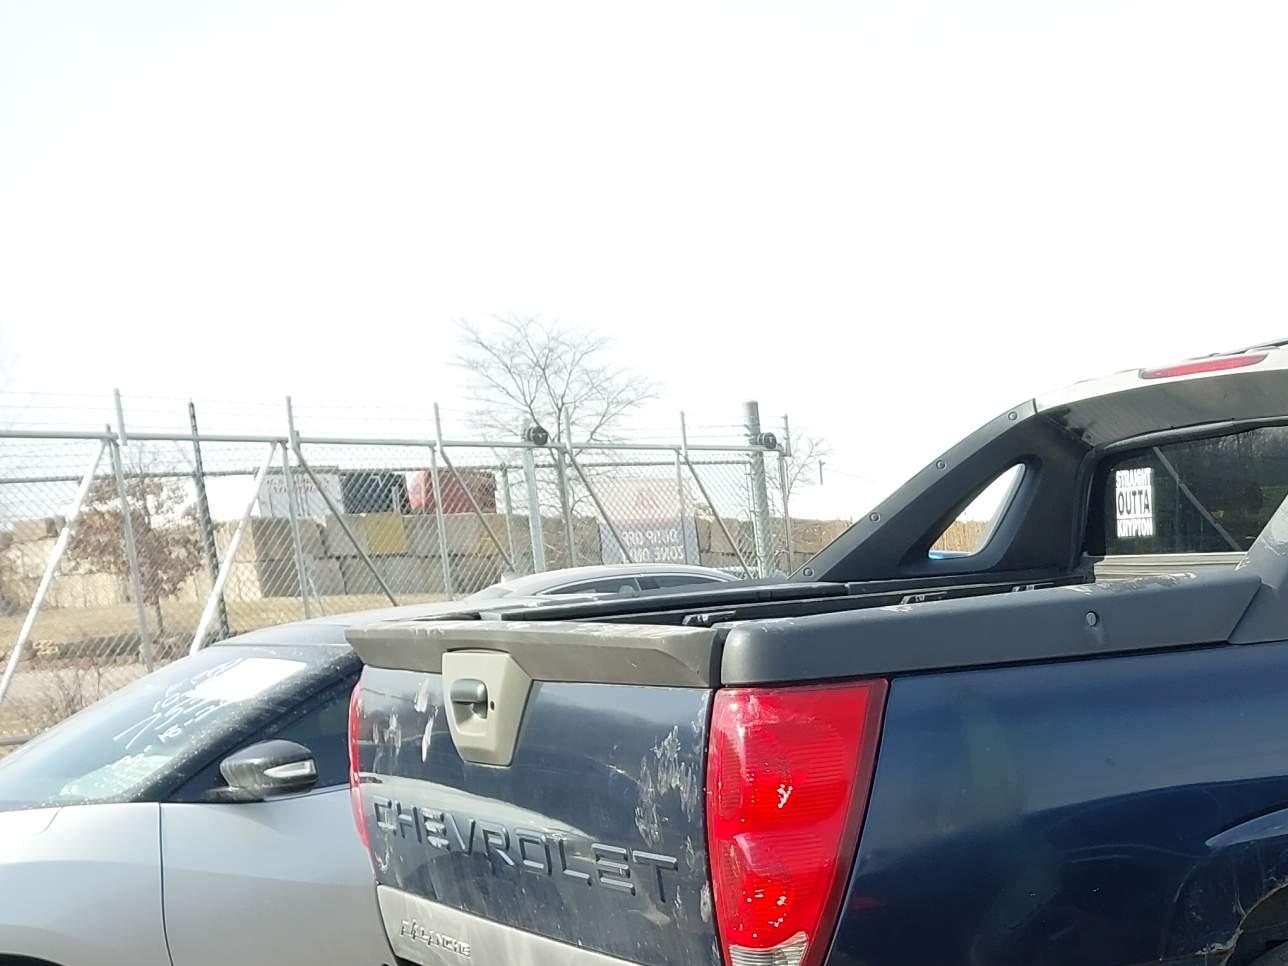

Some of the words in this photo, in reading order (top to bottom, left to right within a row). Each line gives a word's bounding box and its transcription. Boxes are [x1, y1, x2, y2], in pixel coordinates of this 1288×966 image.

[1116, 467, 1152, 488] STRAIGHT
[1117, 489, 1150, 515] OUTTA
[1117, 517, 1153, 538] KRYPTON
[373, 798, 679, 902] CHEVROLET
